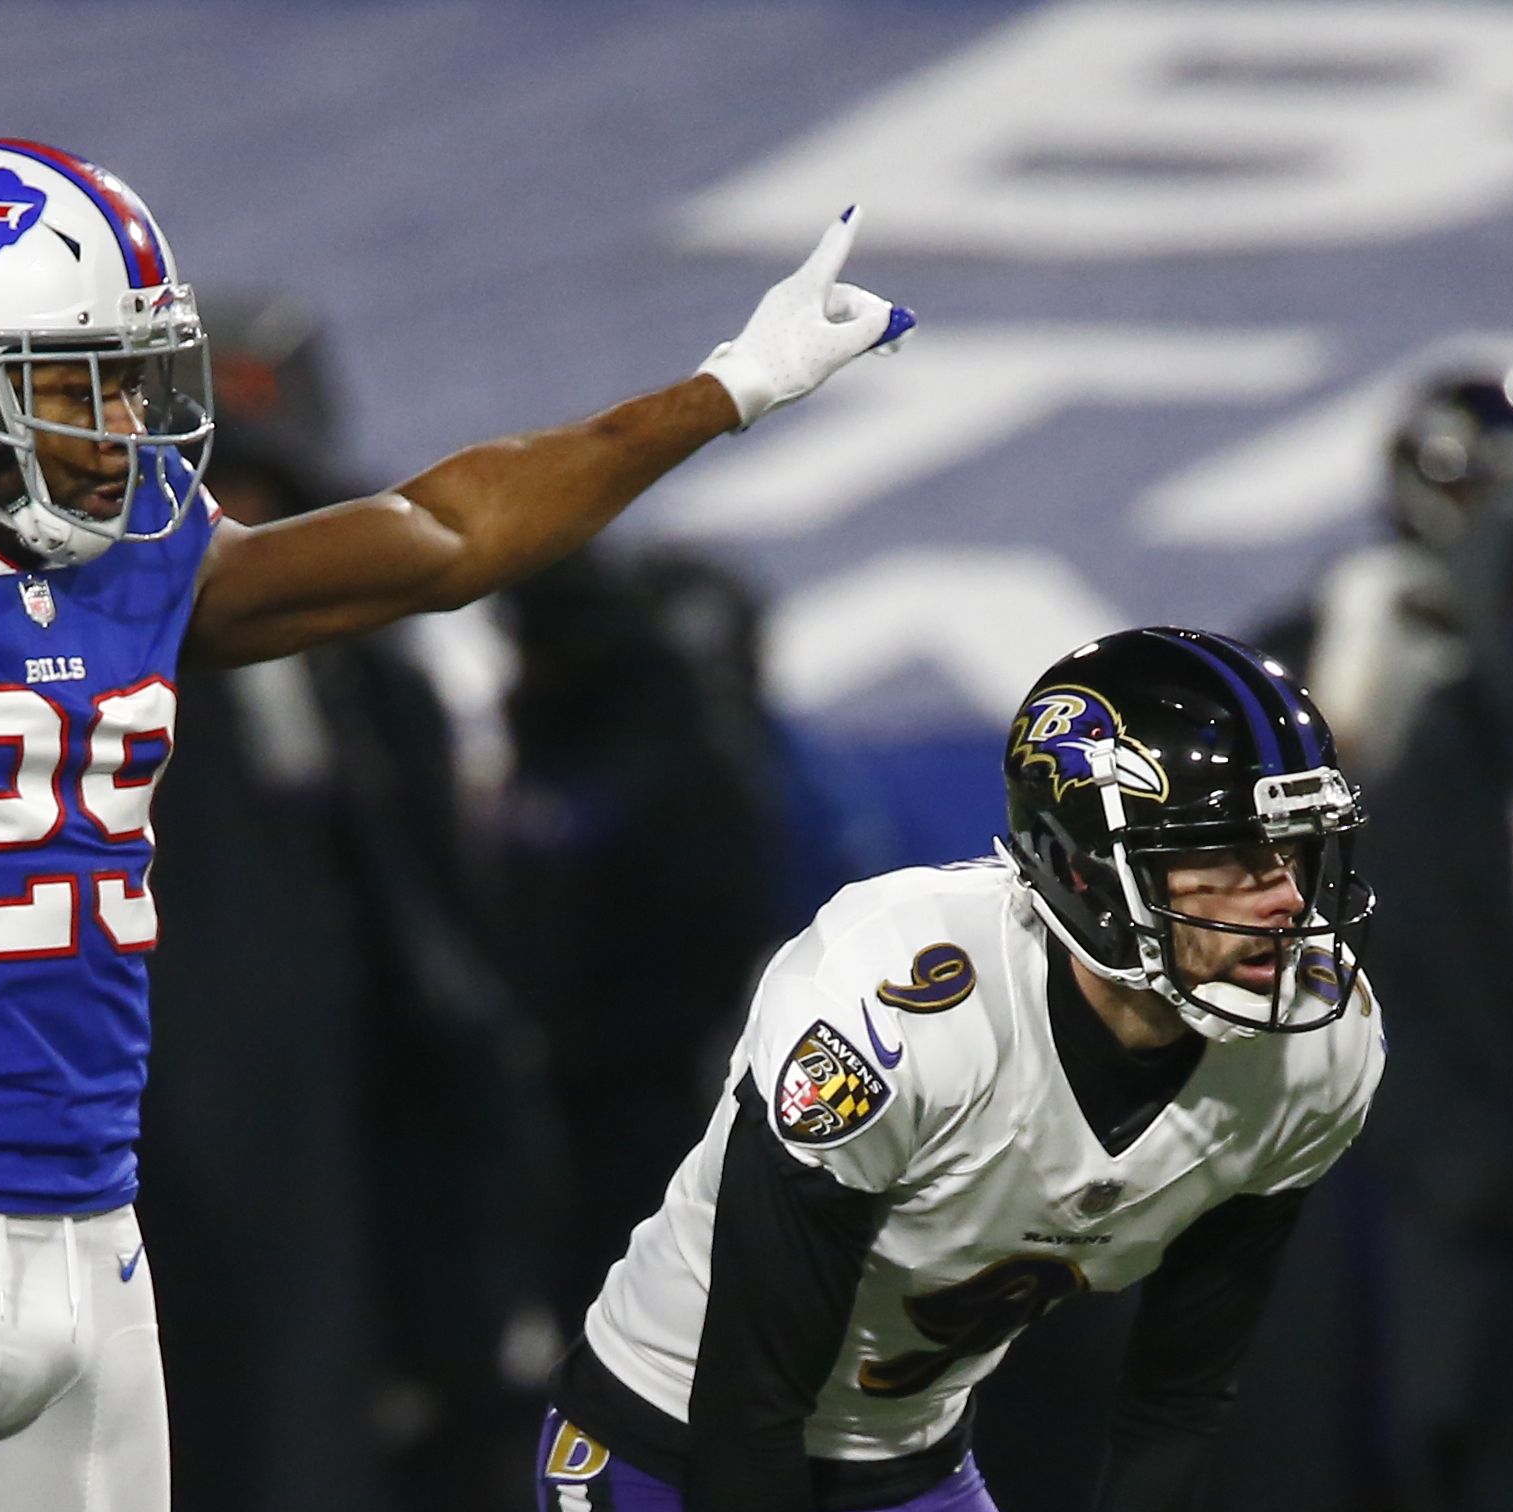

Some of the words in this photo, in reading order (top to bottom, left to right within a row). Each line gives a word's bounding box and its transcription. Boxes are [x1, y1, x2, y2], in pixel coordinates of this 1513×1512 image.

[25, 656, 86, 684] BILLS
[876, 941, 978, 1014] 9
[816, 1024, 883, 1095] RAVENS
[857, 1252, 1091, 1398] 9
